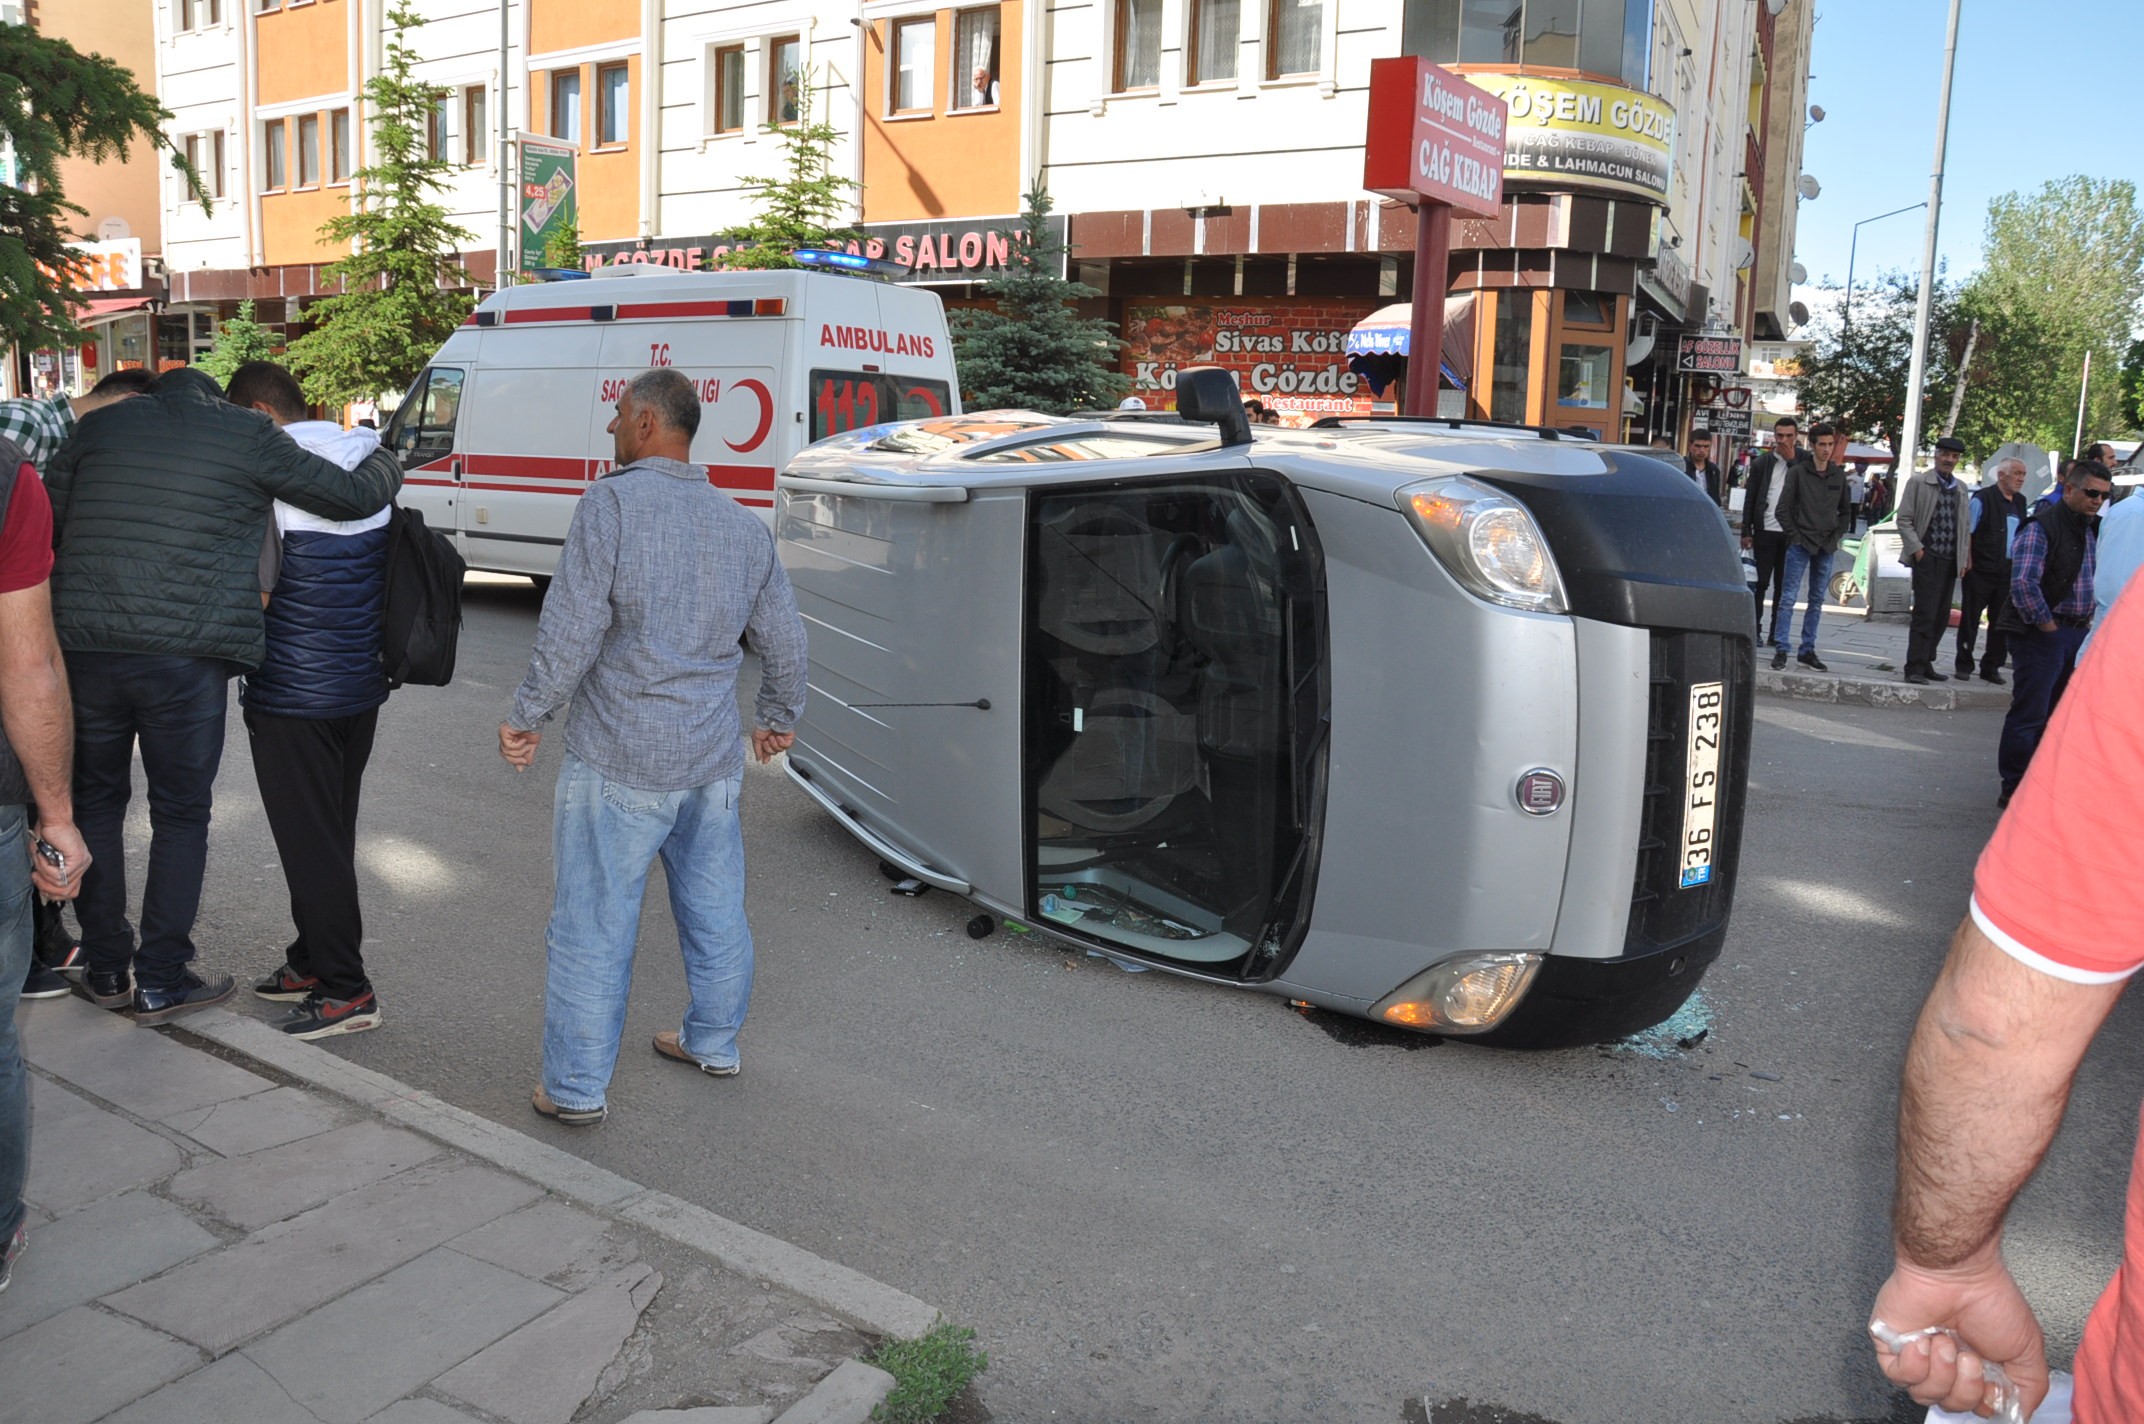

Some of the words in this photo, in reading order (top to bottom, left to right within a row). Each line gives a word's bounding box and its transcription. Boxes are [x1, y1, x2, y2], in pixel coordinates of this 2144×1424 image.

[1423, 72, 1464, 123] Köşem
[1466, 95, 1502, 140] Gözde
[1497, 84, 1602, 127] ÖŞEM
[1610, 100, 1672, 146] GÖZDE
[1565, 136, 1614, 154] KEBAP
[1624, 145, 1656, 167] DÖNER
[1452, 153, 1498, 201] KEBAP
[1503, 151, 1531, 166] İDE
[1537, 155, 1549, 167] &
[1555, 156, 1634, 179] LAHMACUN
[1635, 170, 1666, 190] SALONU
[525, 185, 545, 197] 4,25
[1217, 311, 1272, 329] Meşhur
[650, 343, 672, 367] T.C.
[820, 323, 935, 359] AMBULANS
[1215, 330, 1284, 353] Sivas
[1290, 330, 1349, 353] Köft
[1681, 341, 1694, 354] AF
[1695, 338, 1740, 356] GÜZELLİK
[1251, 363, 1358, 394] Gözde
[1696, 356, 1735, 370] SALONU
[817, 378, 878, 438] 112
[1262, 395, 1353, 411] Restaurant
[1695, 690, 1720, 751] 238
[1530, 778, 1553, 805] FIAT
[1692, 770, 1715, 809] FS
[1687, 828, 1711, 866] 36
[1698, 866, 1707, 881] TR
